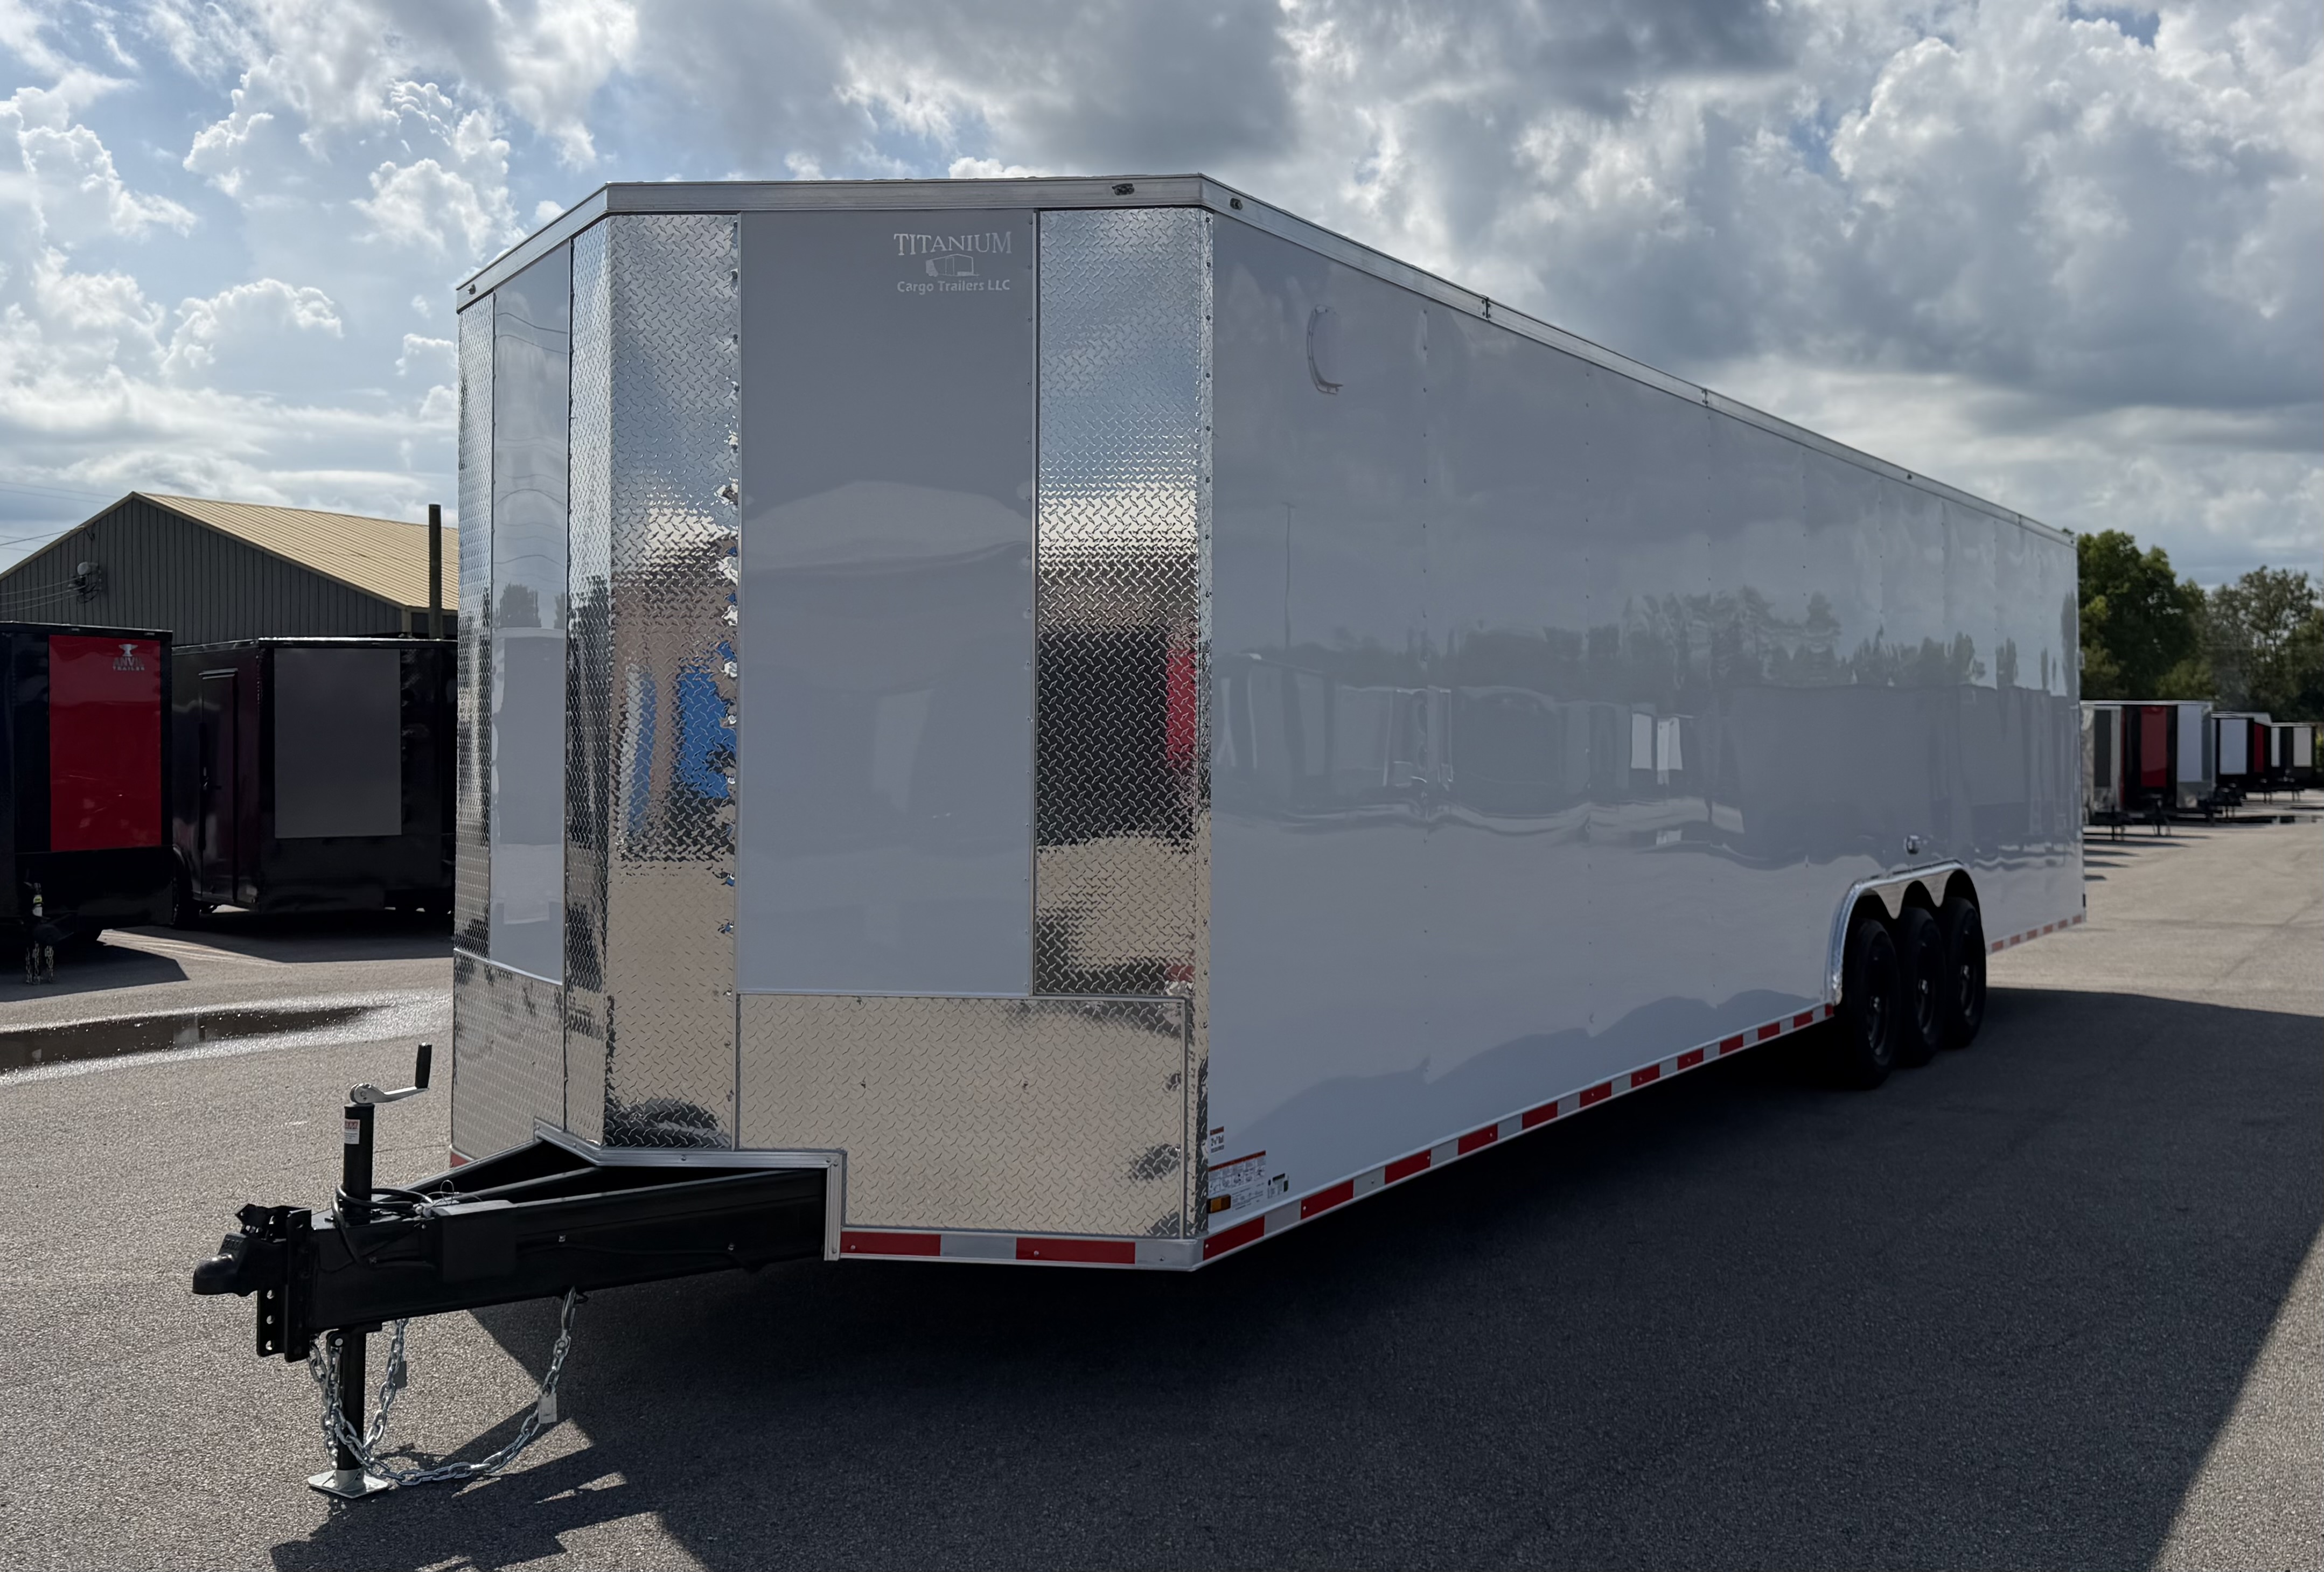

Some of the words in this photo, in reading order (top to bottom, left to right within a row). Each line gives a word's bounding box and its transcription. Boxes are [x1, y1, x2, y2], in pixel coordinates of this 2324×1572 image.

[894, 232, 1011, 255] TITANIUM
[897, 281, 934, 295] Cargo
[938, 280, 985, 292] Trailers
[988, 279, 1010, 291] LLC
[113, 656, 145, 666] ANVIL
